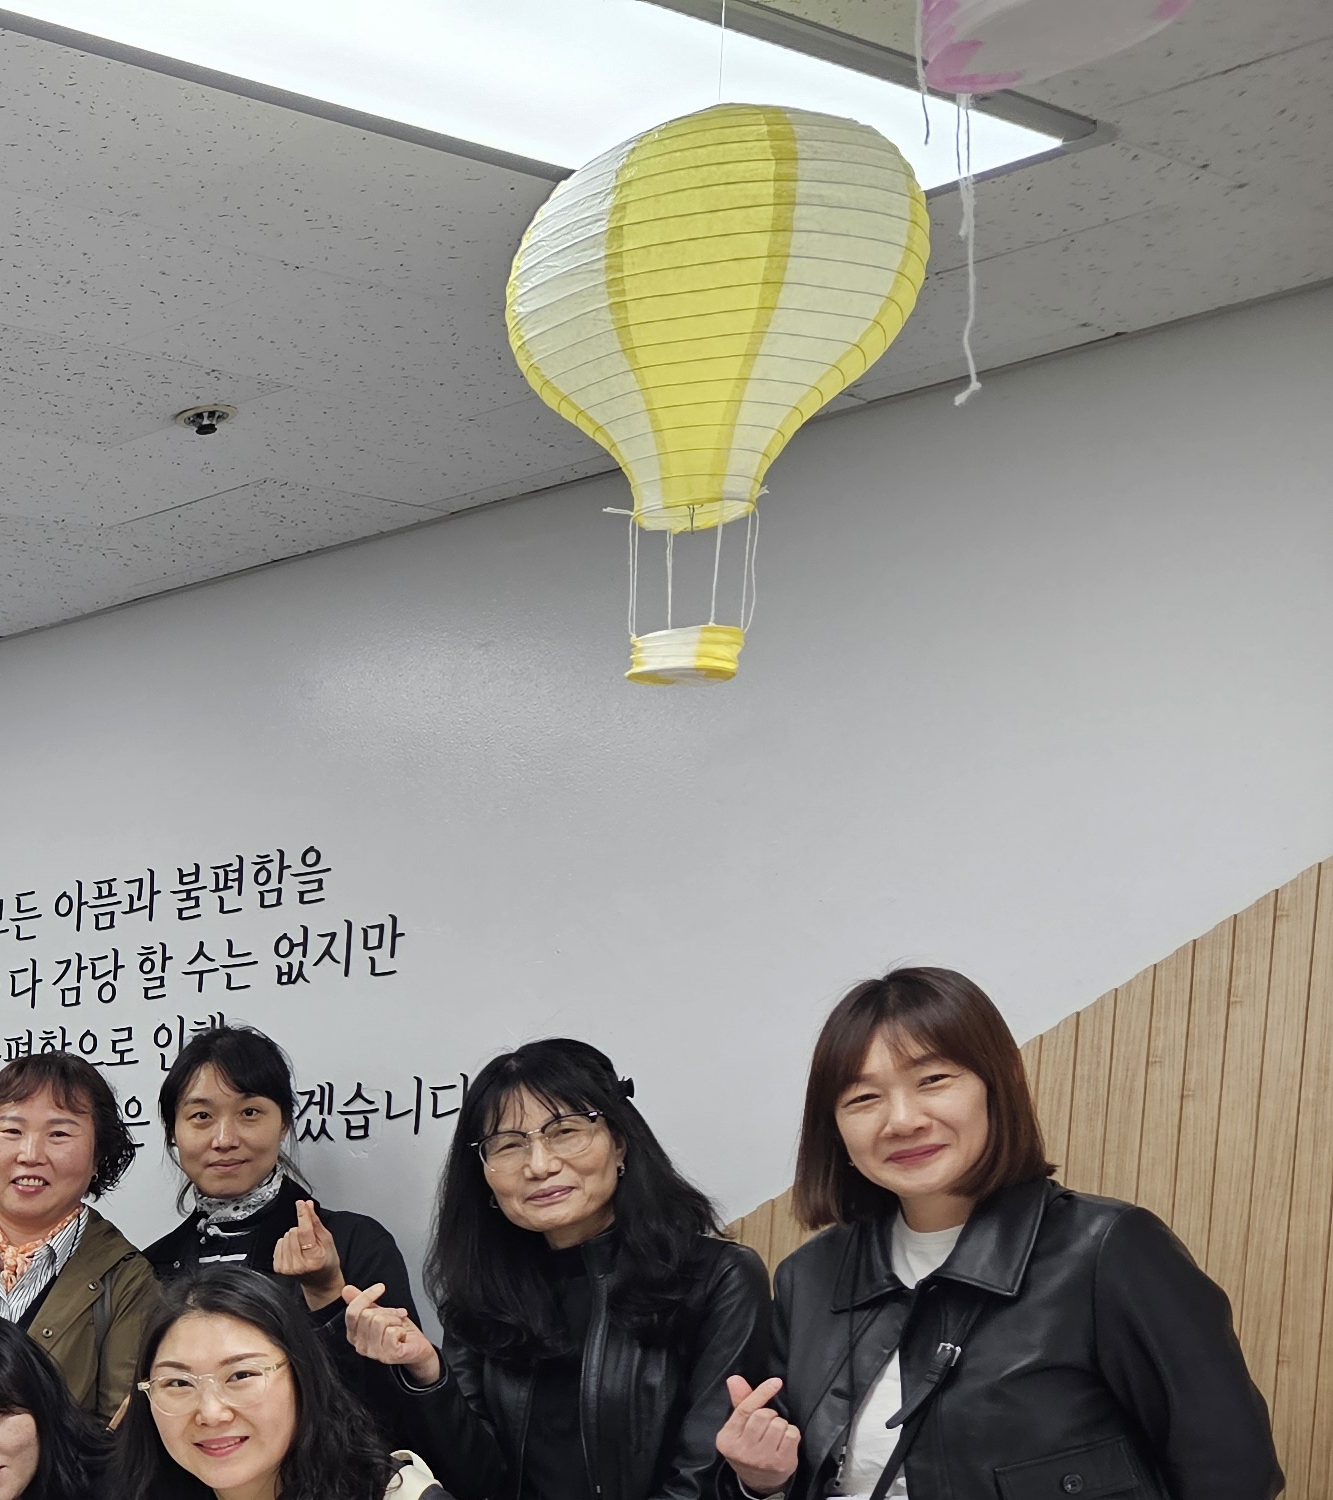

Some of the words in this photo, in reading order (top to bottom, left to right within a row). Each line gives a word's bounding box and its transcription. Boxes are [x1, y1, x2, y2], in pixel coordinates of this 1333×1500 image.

[54, 868, 161, 932] 아픔과
[170, 846, 332, 921] 불편함을
[9, 958, 43, 1010] 다
[52, 947, 125, 1008] 감당
[137, 941, 173, 1000] 할
[181, 938, 258, 993] 수는
[273, 913, 405, 985] 없지만
